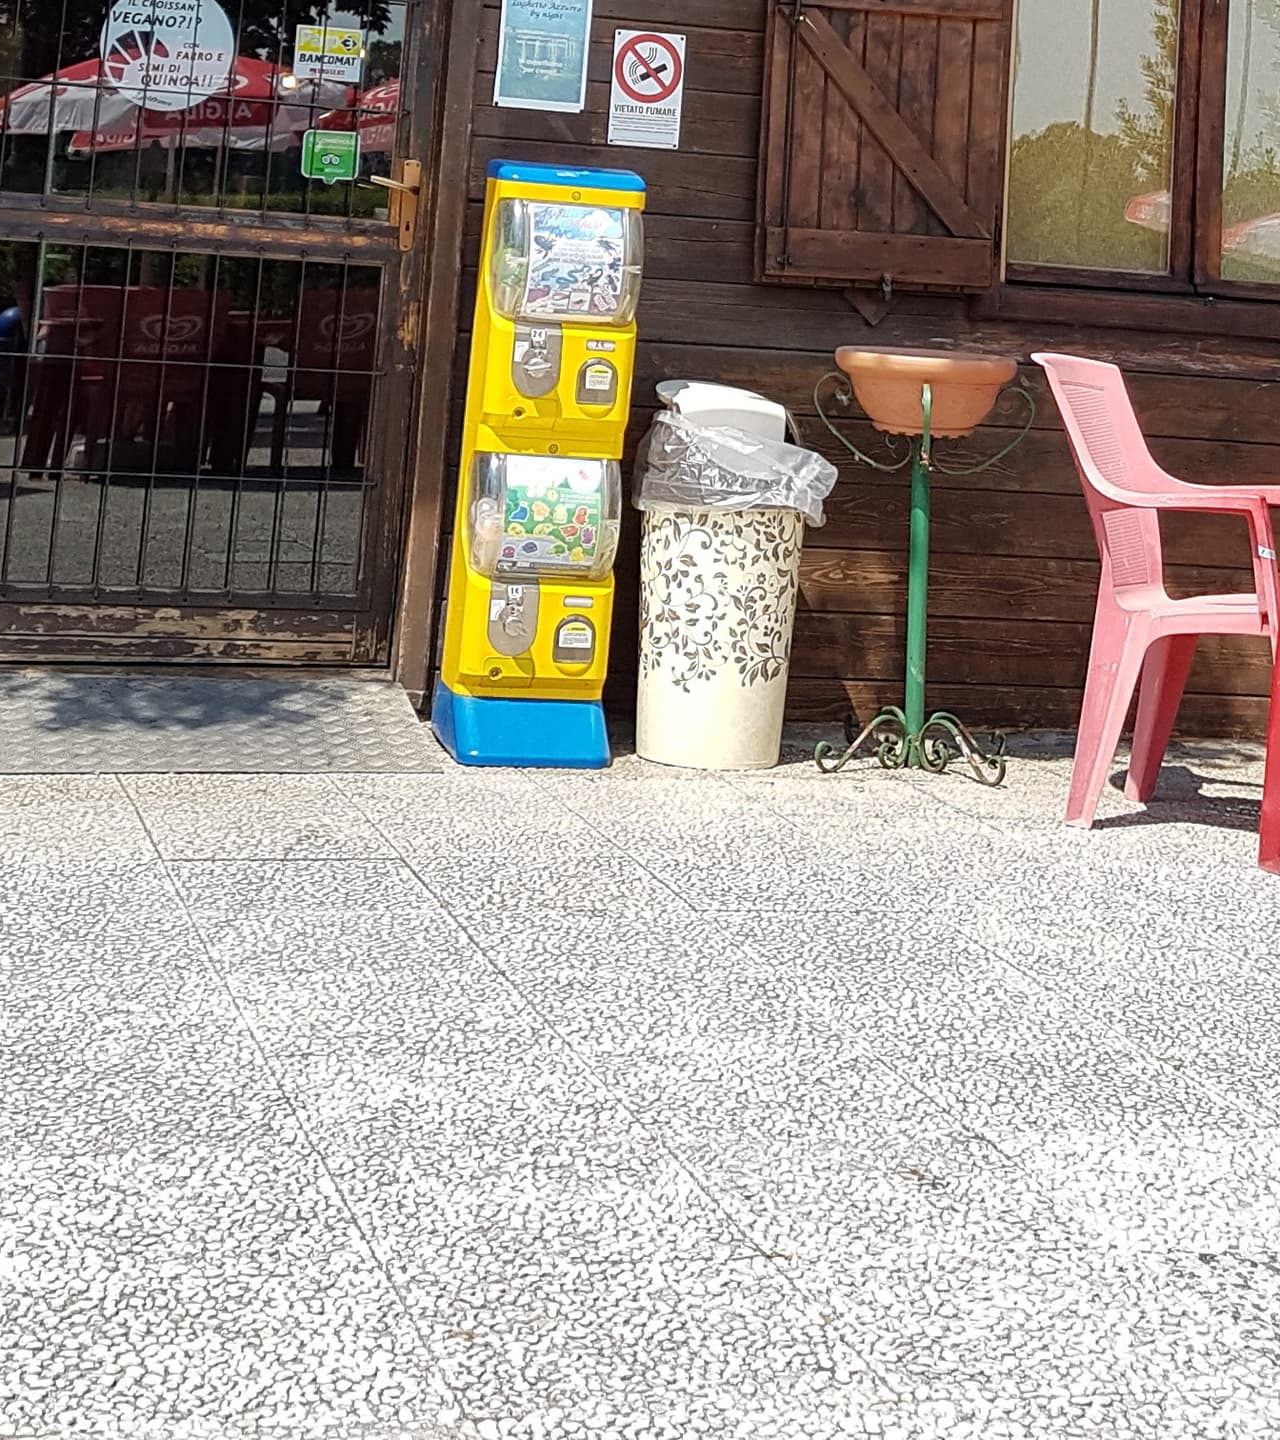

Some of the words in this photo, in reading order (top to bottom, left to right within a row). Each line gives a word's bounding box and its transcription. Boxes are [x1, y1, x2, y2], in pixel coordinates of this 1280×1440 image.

[216, 53, 224, 61] E
[299, 53, 357, 66] BANCOMAT
[138, 63, 164, 72] SMI
[169, 64, 180, 72] DI
[614, 104, 644, 114] VIETATO
[645, 107, 676, 116] FUMARE
